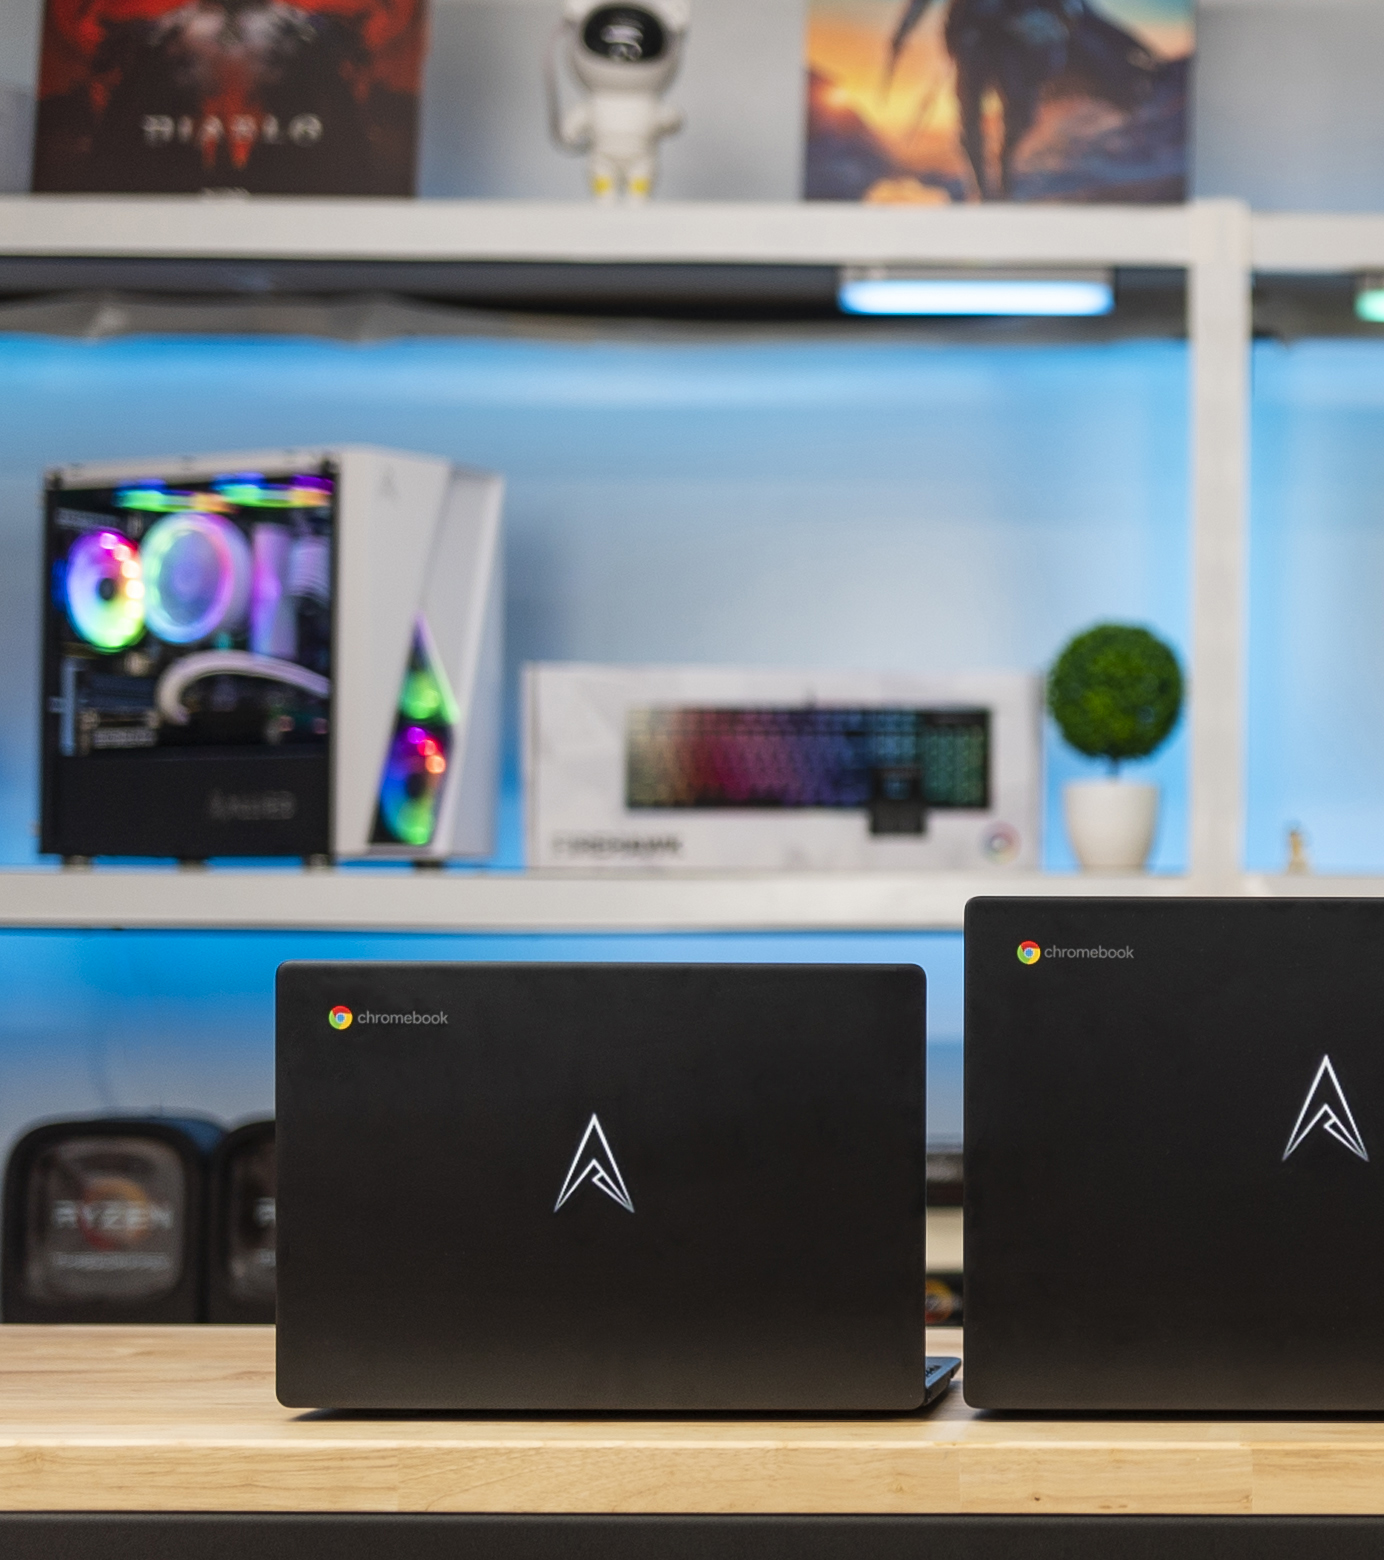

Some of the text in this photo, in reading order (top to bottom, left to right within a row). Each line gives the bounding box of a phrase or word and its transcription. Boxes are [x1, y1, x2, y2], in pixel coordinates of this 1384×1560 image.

[142, 114, 324, 145] DIABLO
[1044, 945, 1135, 959] chromebook
[357, 1010, 449, 1025] chromebook
[54, 1201, 176, 1229] RYZEN
